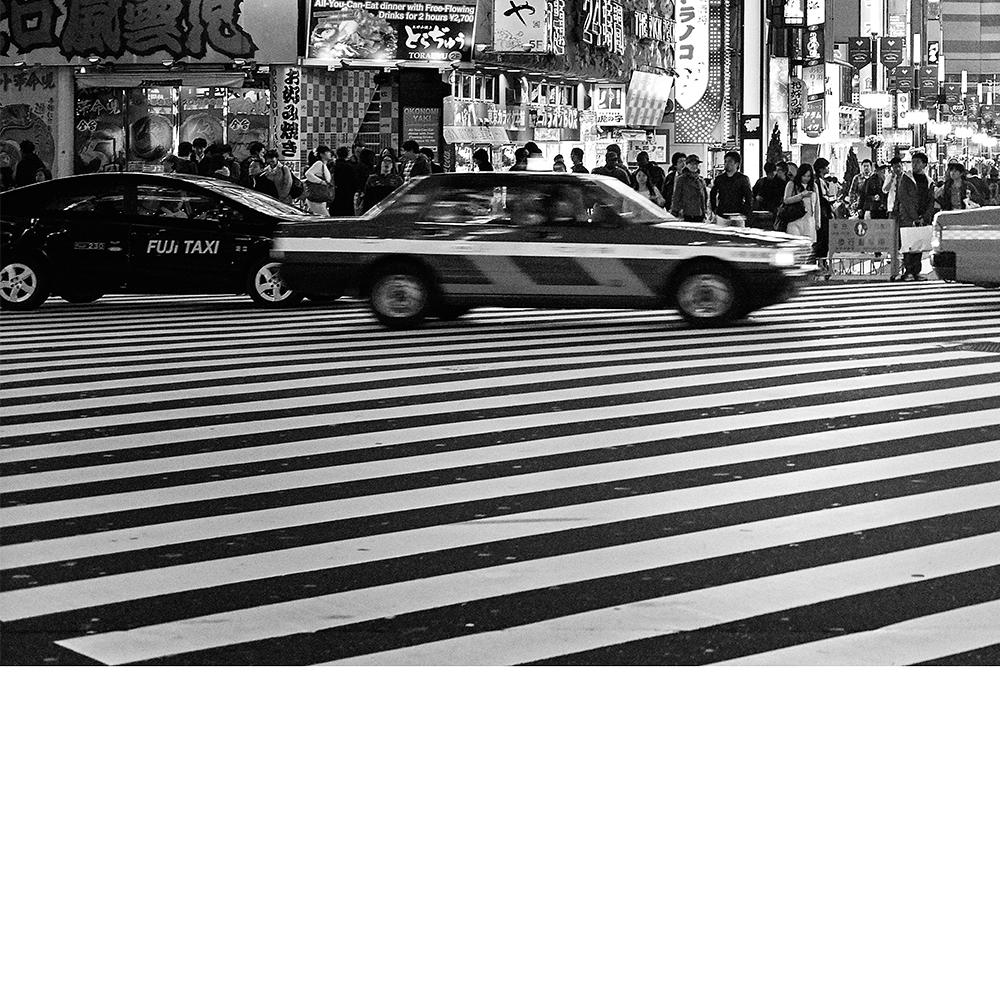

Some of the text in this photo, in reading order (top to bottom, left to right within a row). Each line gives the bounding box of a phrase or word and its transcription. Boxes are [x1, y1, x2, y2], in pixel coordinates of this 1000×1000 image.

[380, 1, 406, 11] dinner
[407, 3, 424, 12] with
[425, 3, 475, 16] Free-Flowing
[378, 10, 403, 21] Drinks
[404, 12, 417, 20] for
[418, 12, 424, 21] 2
[425, 13, 449, 22] hours
[529, 40, 543, 48] 5F
[184, 240, 220, 254] TAXI
